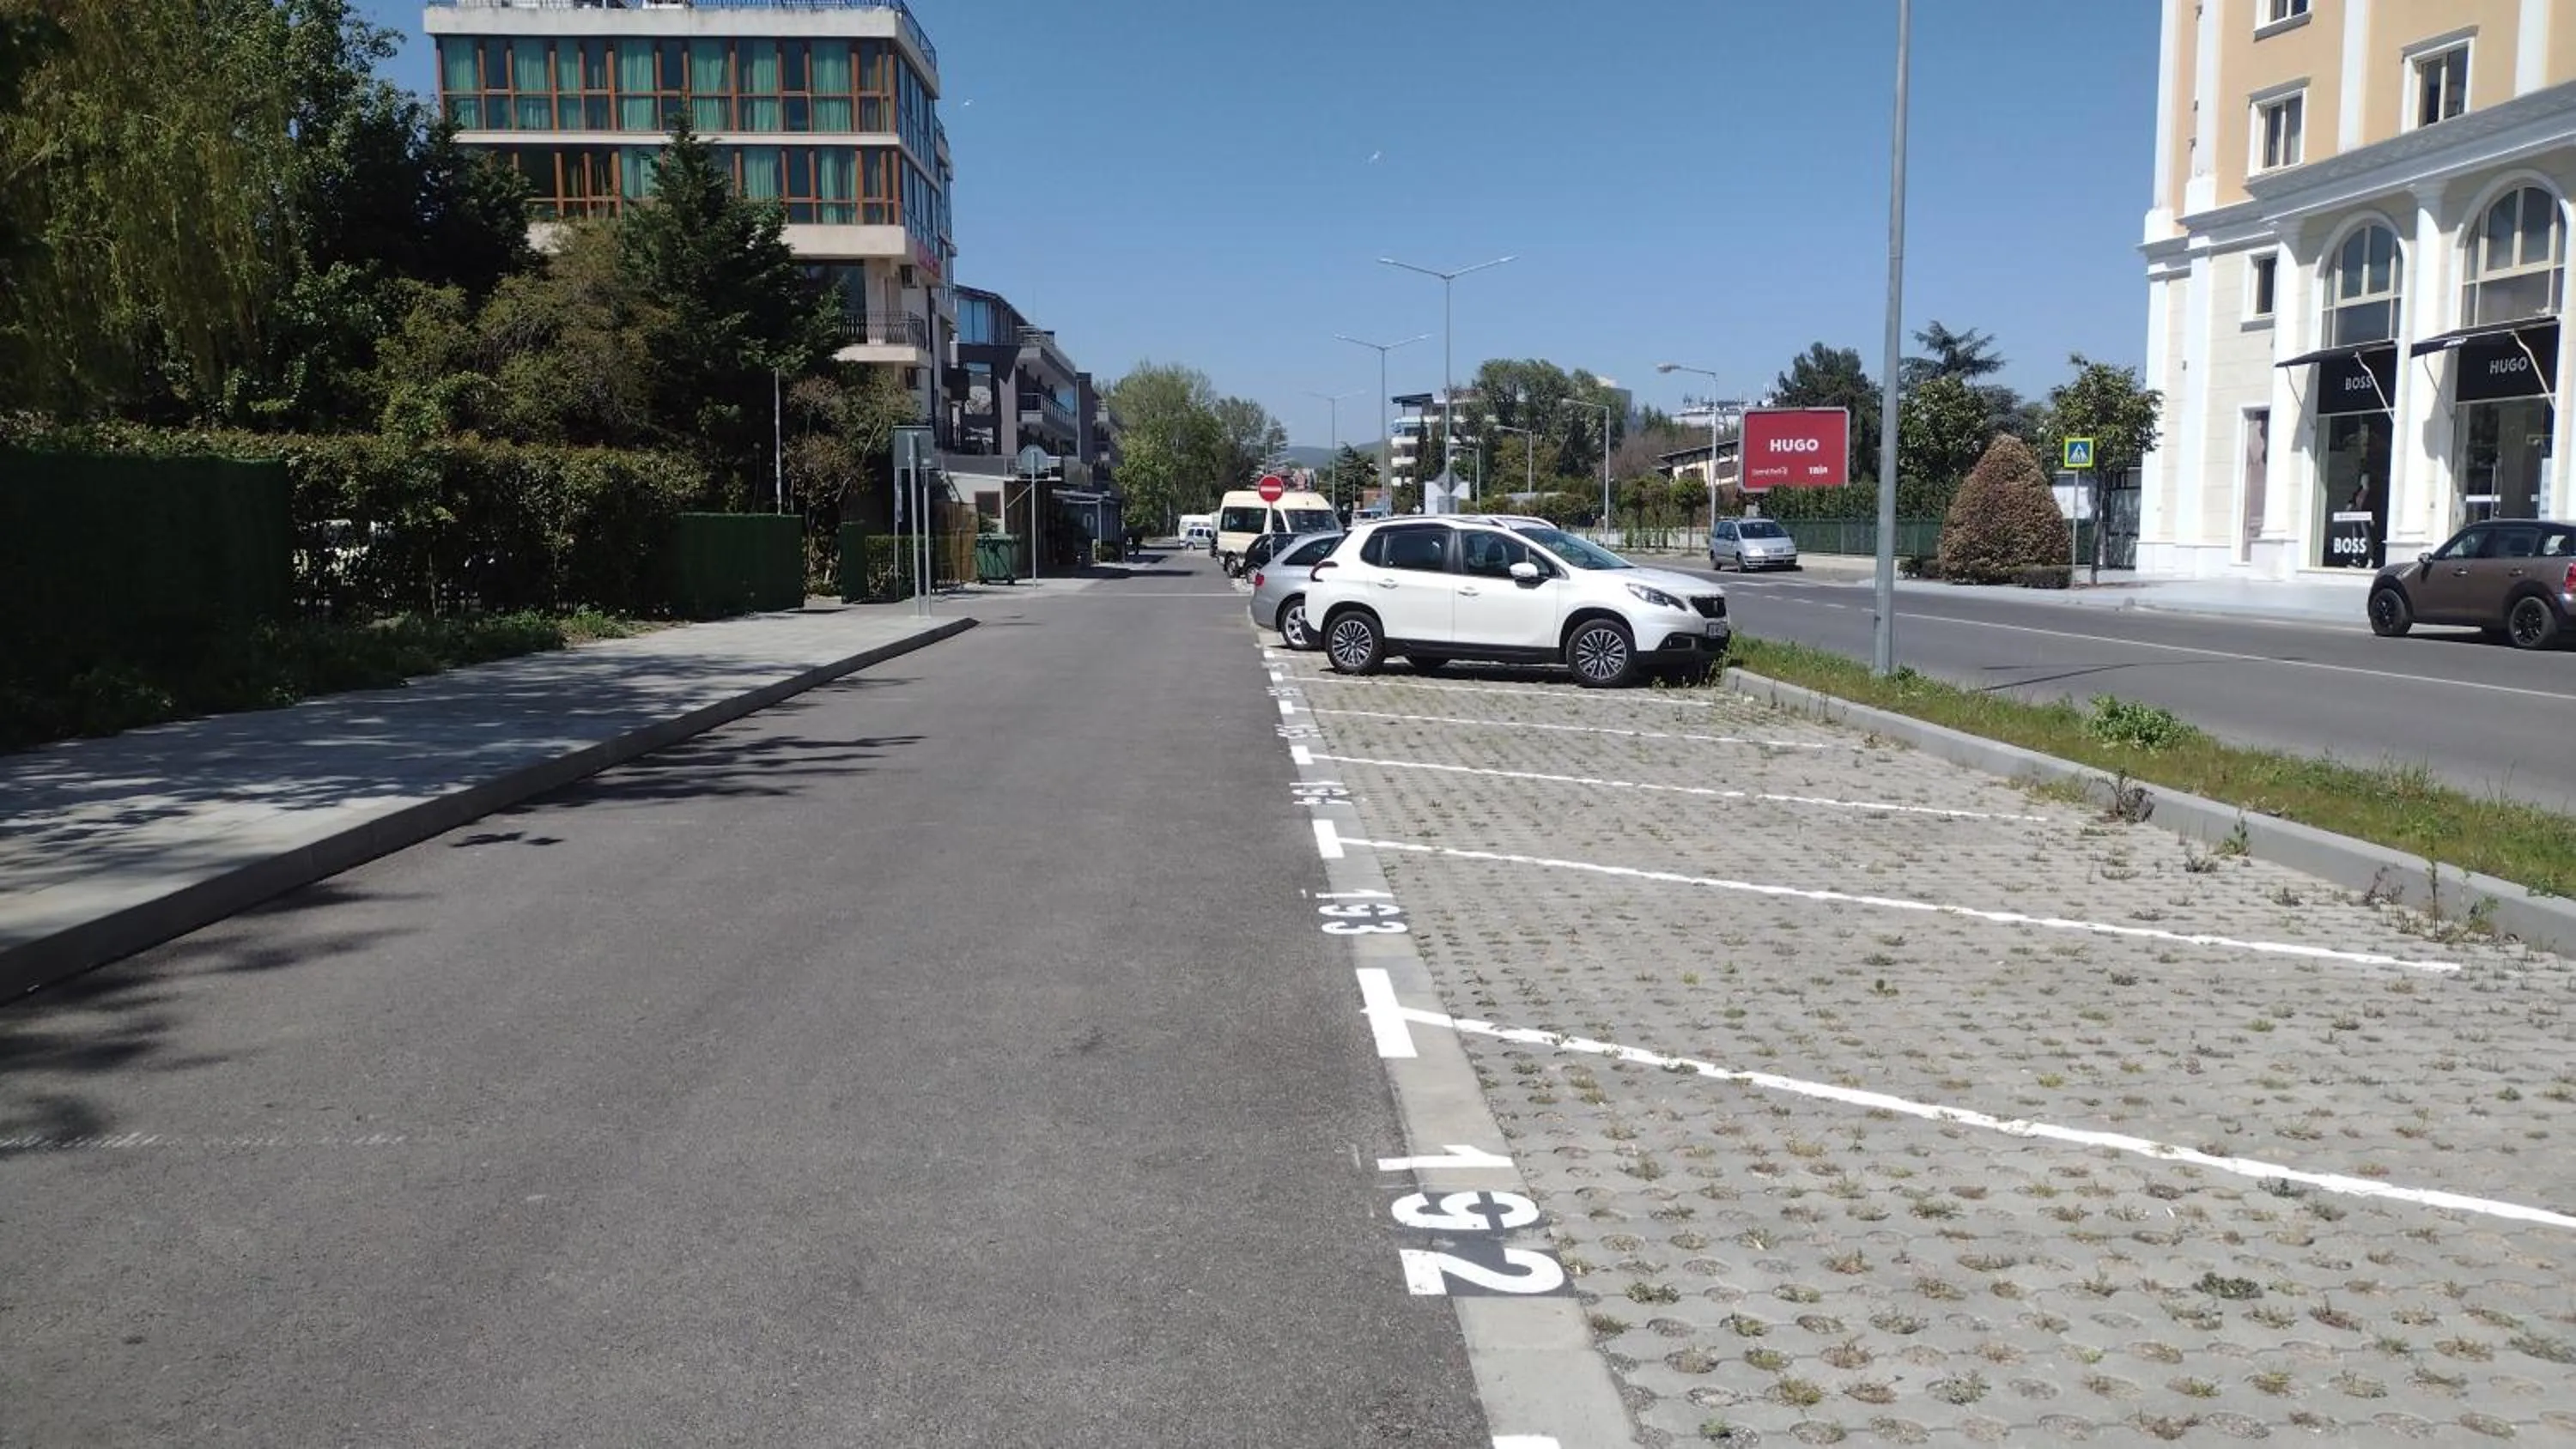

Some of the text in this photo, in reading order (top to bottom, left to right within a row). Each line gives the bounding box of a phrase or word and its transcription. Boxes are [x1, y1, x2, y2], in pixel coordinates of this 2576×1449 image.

[2490, 356, 2529, 374] HUGO
[2345, 375, 2372, 391] BOSS
[1770, 439, 1820, 452] HUGO
[2333, 537, 2367, 554] BOSS
[1289, 780, 1352, 805] 194
[1315, 888, 1409, 937] 193
[1376, 1144, 1564, 1294] 192
